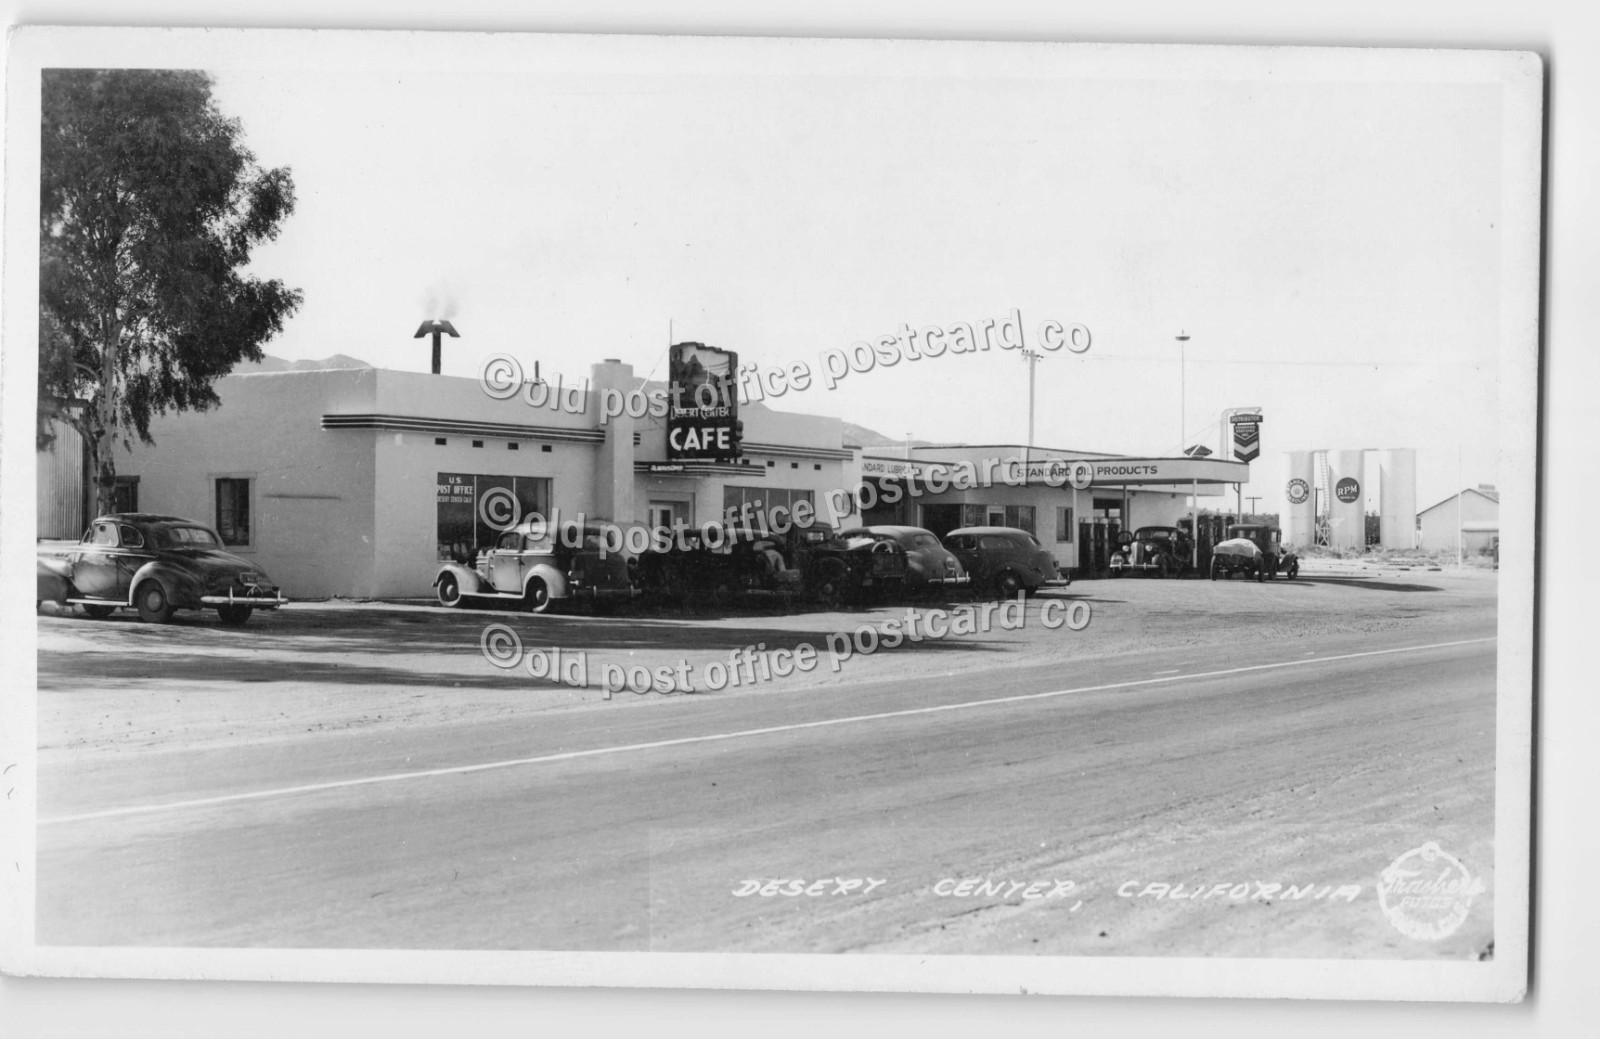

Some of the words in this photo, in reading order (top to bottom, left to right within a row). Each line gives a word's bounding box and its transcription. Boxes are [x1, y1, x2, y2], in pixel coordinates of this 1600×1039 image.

[669, 427, 730, 451] CAFE
[1017, 467, 1069, 477] STANDARD
[1097, 465, 1158, 475] PRODUCTS
[437, 485, 451, 494] POST
[454, 486, 473, 495] OFFICE
[1337, 484, 1358, 496] RPM
